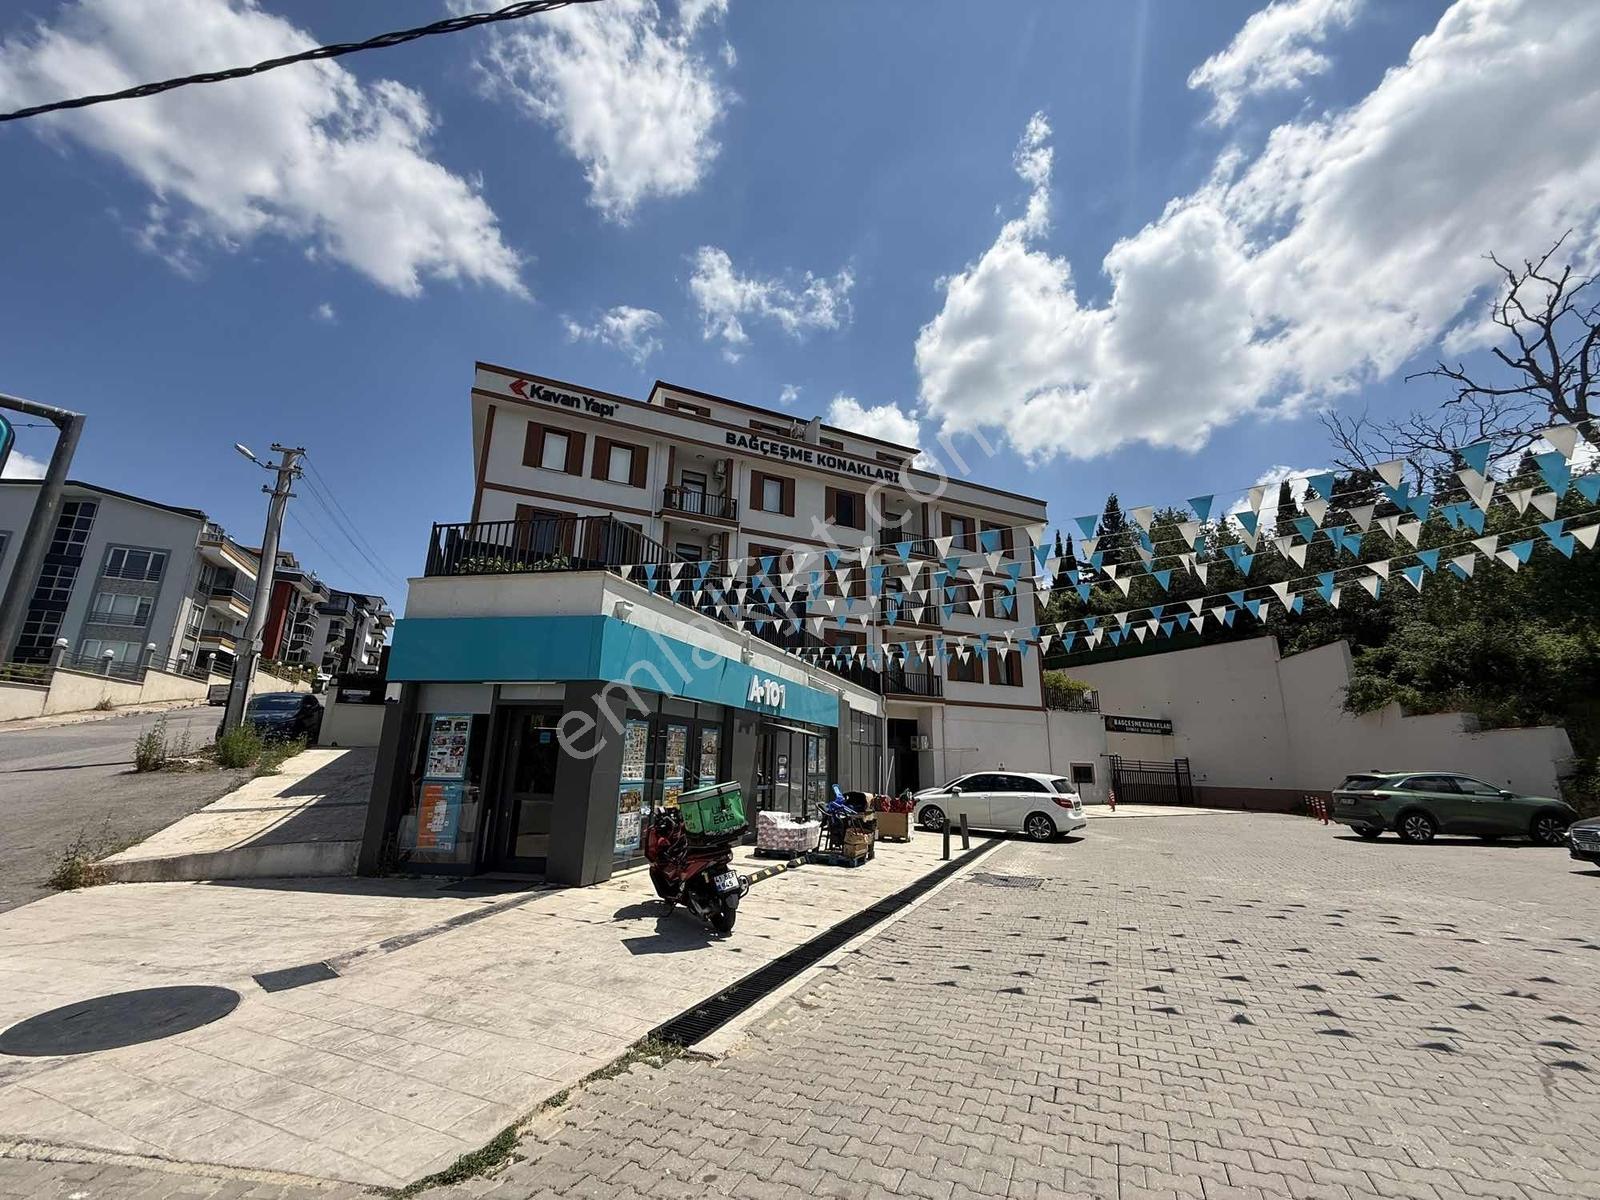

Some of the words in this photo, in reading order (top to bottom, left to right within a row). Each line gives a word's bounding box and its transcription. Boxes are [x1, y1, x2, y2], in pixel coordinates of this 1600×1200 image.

[530, 383, 580, 409] Kavan
[725, 431, 813, 463] BAĞÇEŞME
[817, 453, 900, 484] KONAKLARI
